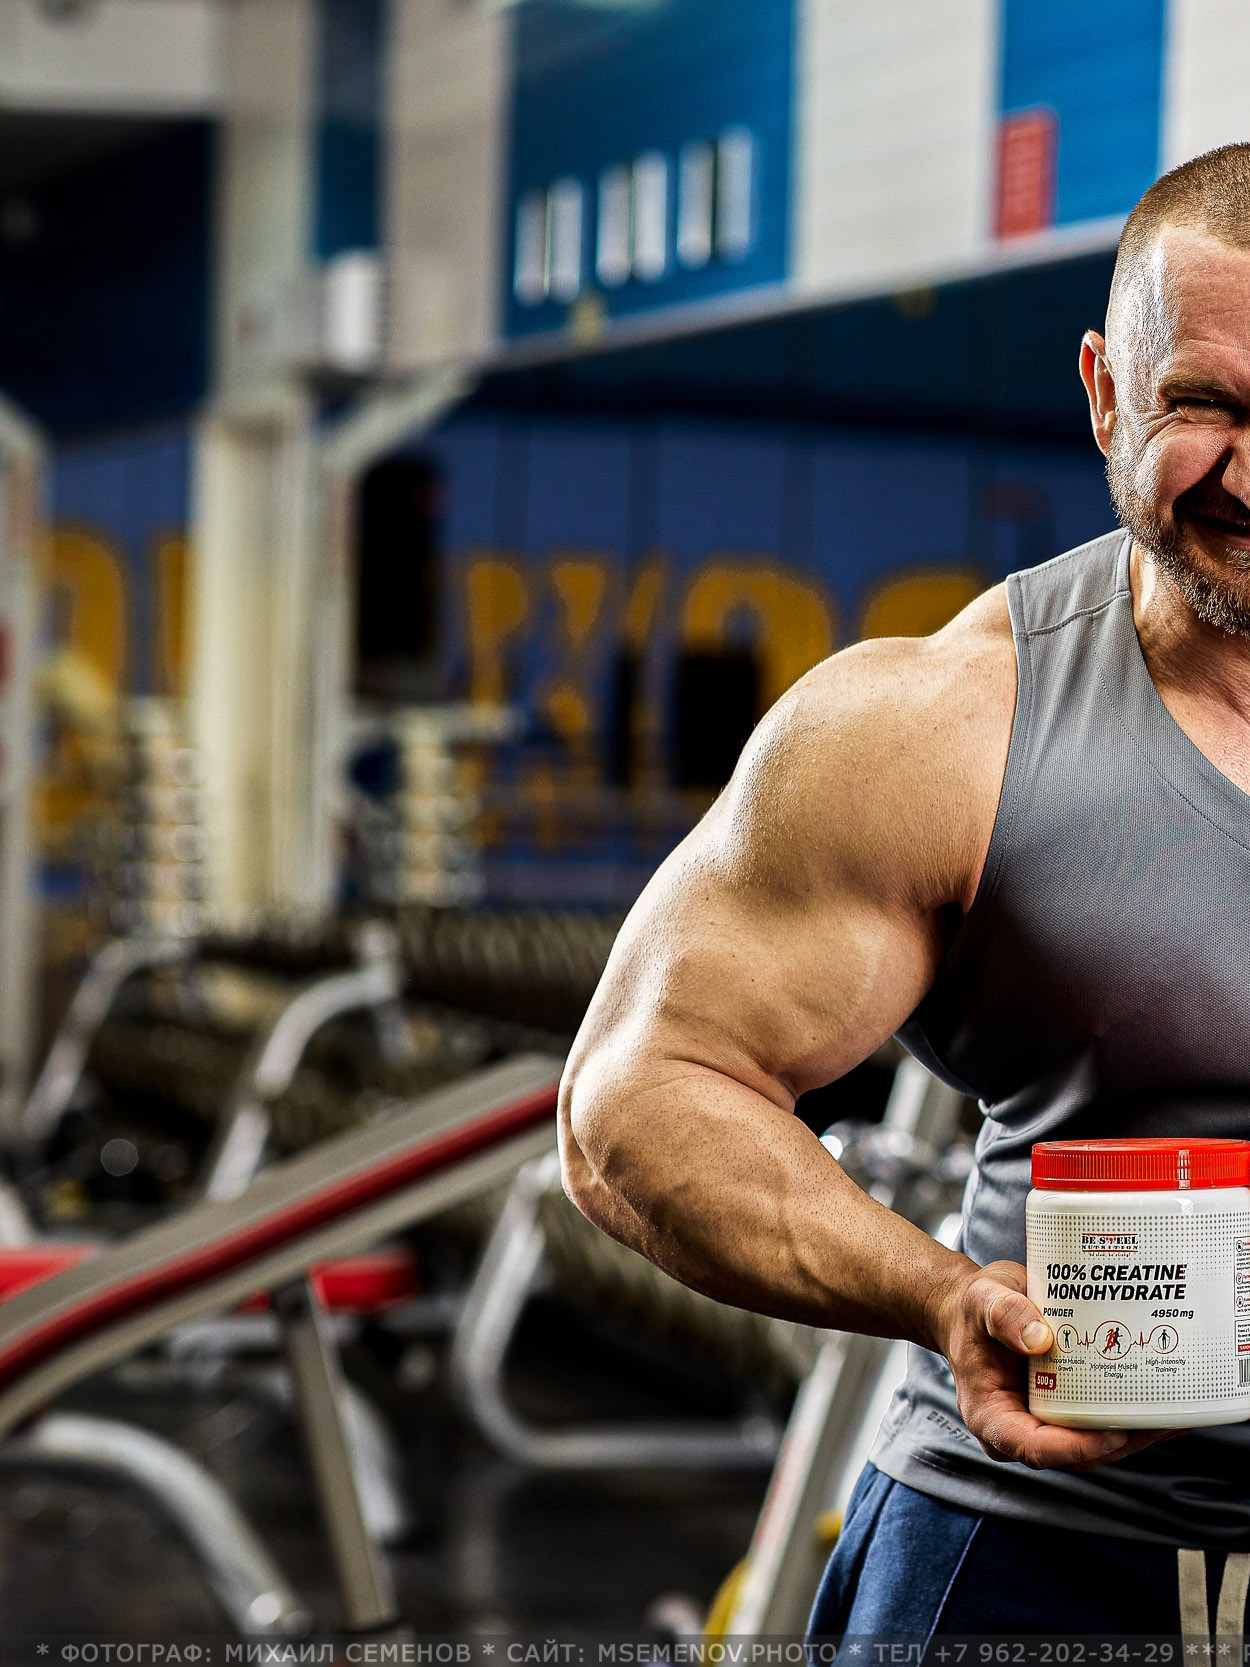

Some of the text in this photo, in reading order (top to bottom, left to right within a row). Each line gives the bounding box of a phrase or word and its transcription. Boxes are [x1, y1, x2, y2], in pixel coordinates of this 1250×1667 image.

[1082, 1235, 1096, 1245] BE
[1046, 1263, 1188, 1281] 100% CREATINE
[1046, 1283, 1187, 1301] MONOHYDRATE
[1043, 1307, 1074, 1318] POWDER
